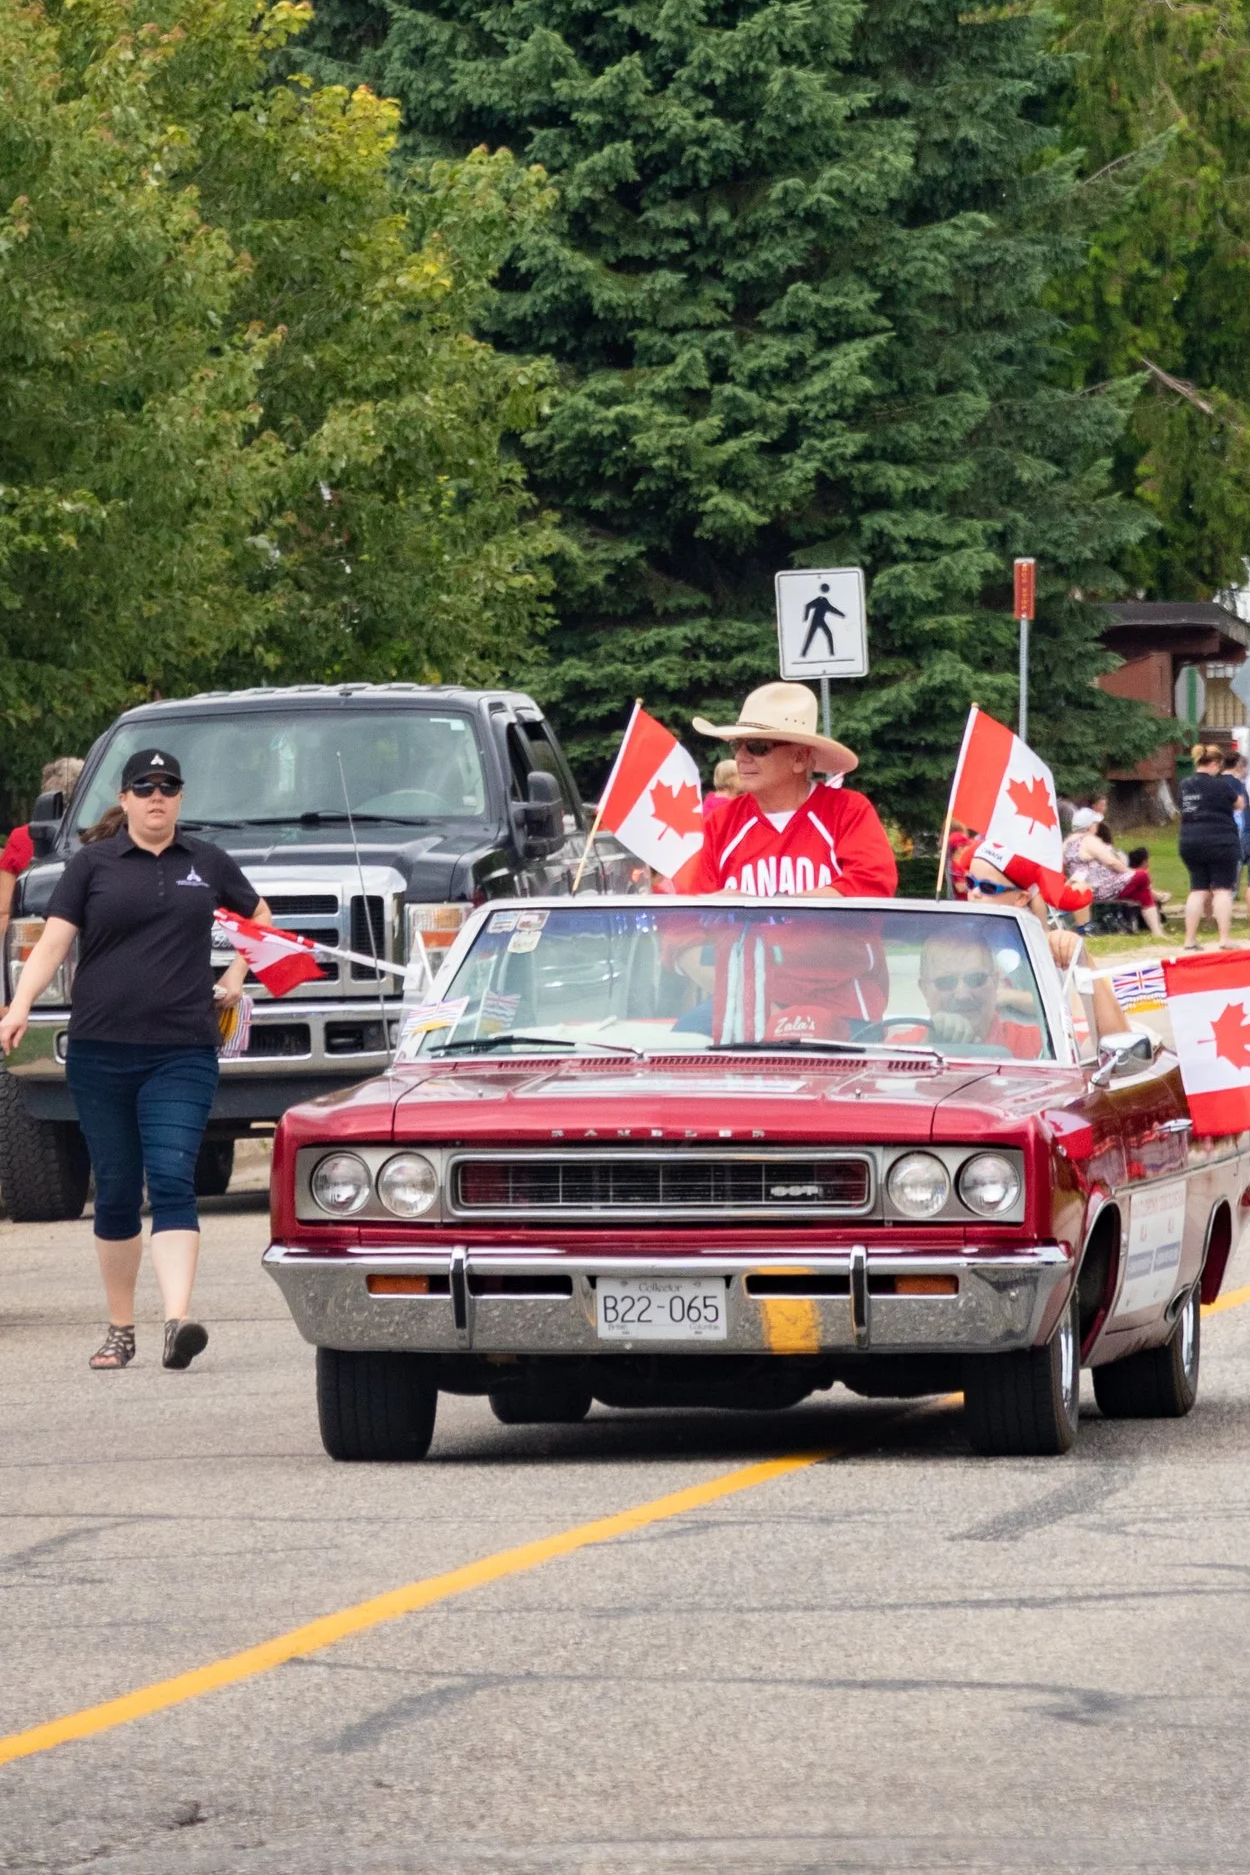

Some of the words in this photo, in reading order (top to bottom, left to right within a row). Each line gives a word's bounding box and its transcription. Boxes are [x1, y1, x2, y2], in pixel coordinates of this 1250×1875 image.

[551, 1129, 765, 1138] RAMBLER
[639, 1283, 682, 1292] Collector
[603, 1295, 719, 1323] B22-065
